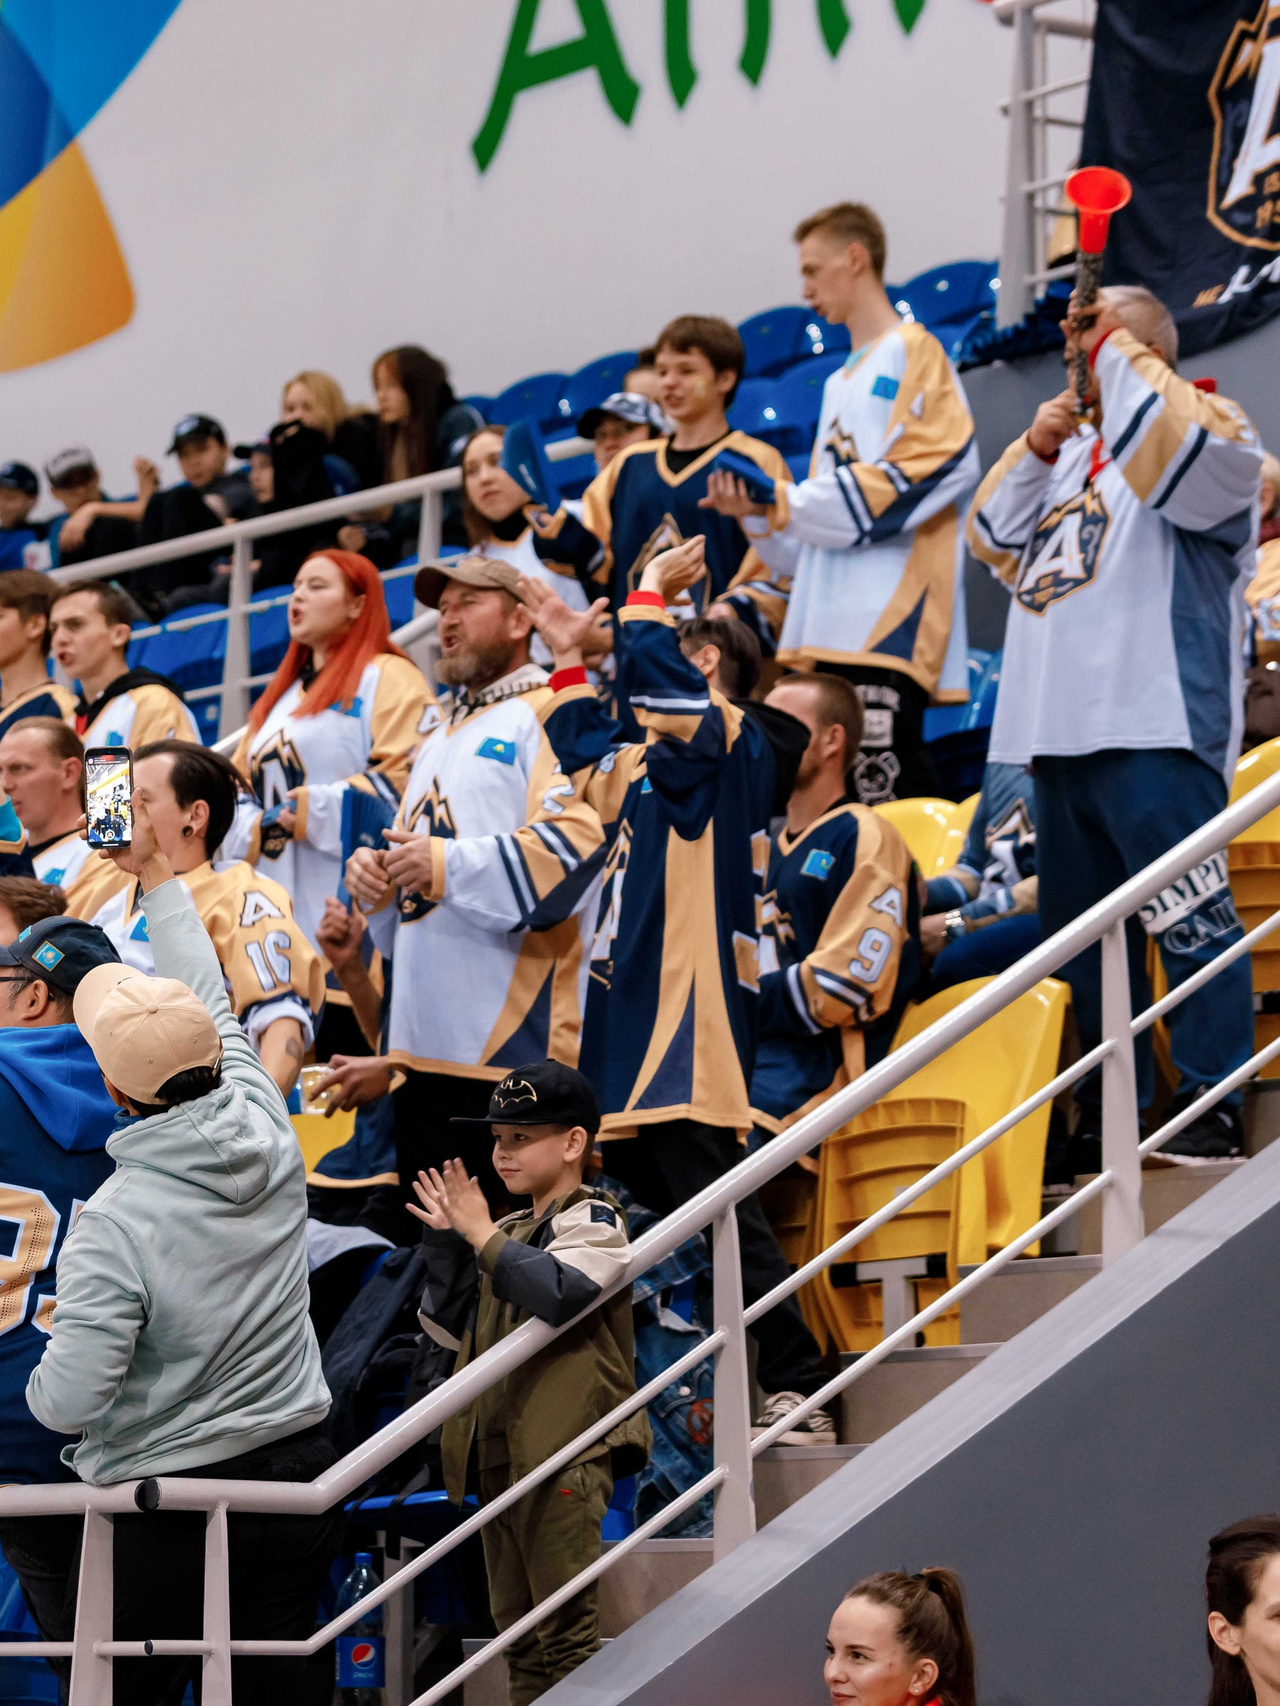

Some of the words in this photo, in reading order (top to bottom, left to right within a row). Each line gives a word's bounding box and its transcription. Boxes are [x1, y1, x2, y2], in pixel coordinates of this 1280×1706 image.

[239, 888, 286, 928] A
[868, 885, 903, 929] A
[245, 930, 291, 993] 16
[849, 927, 893, 983] 9
